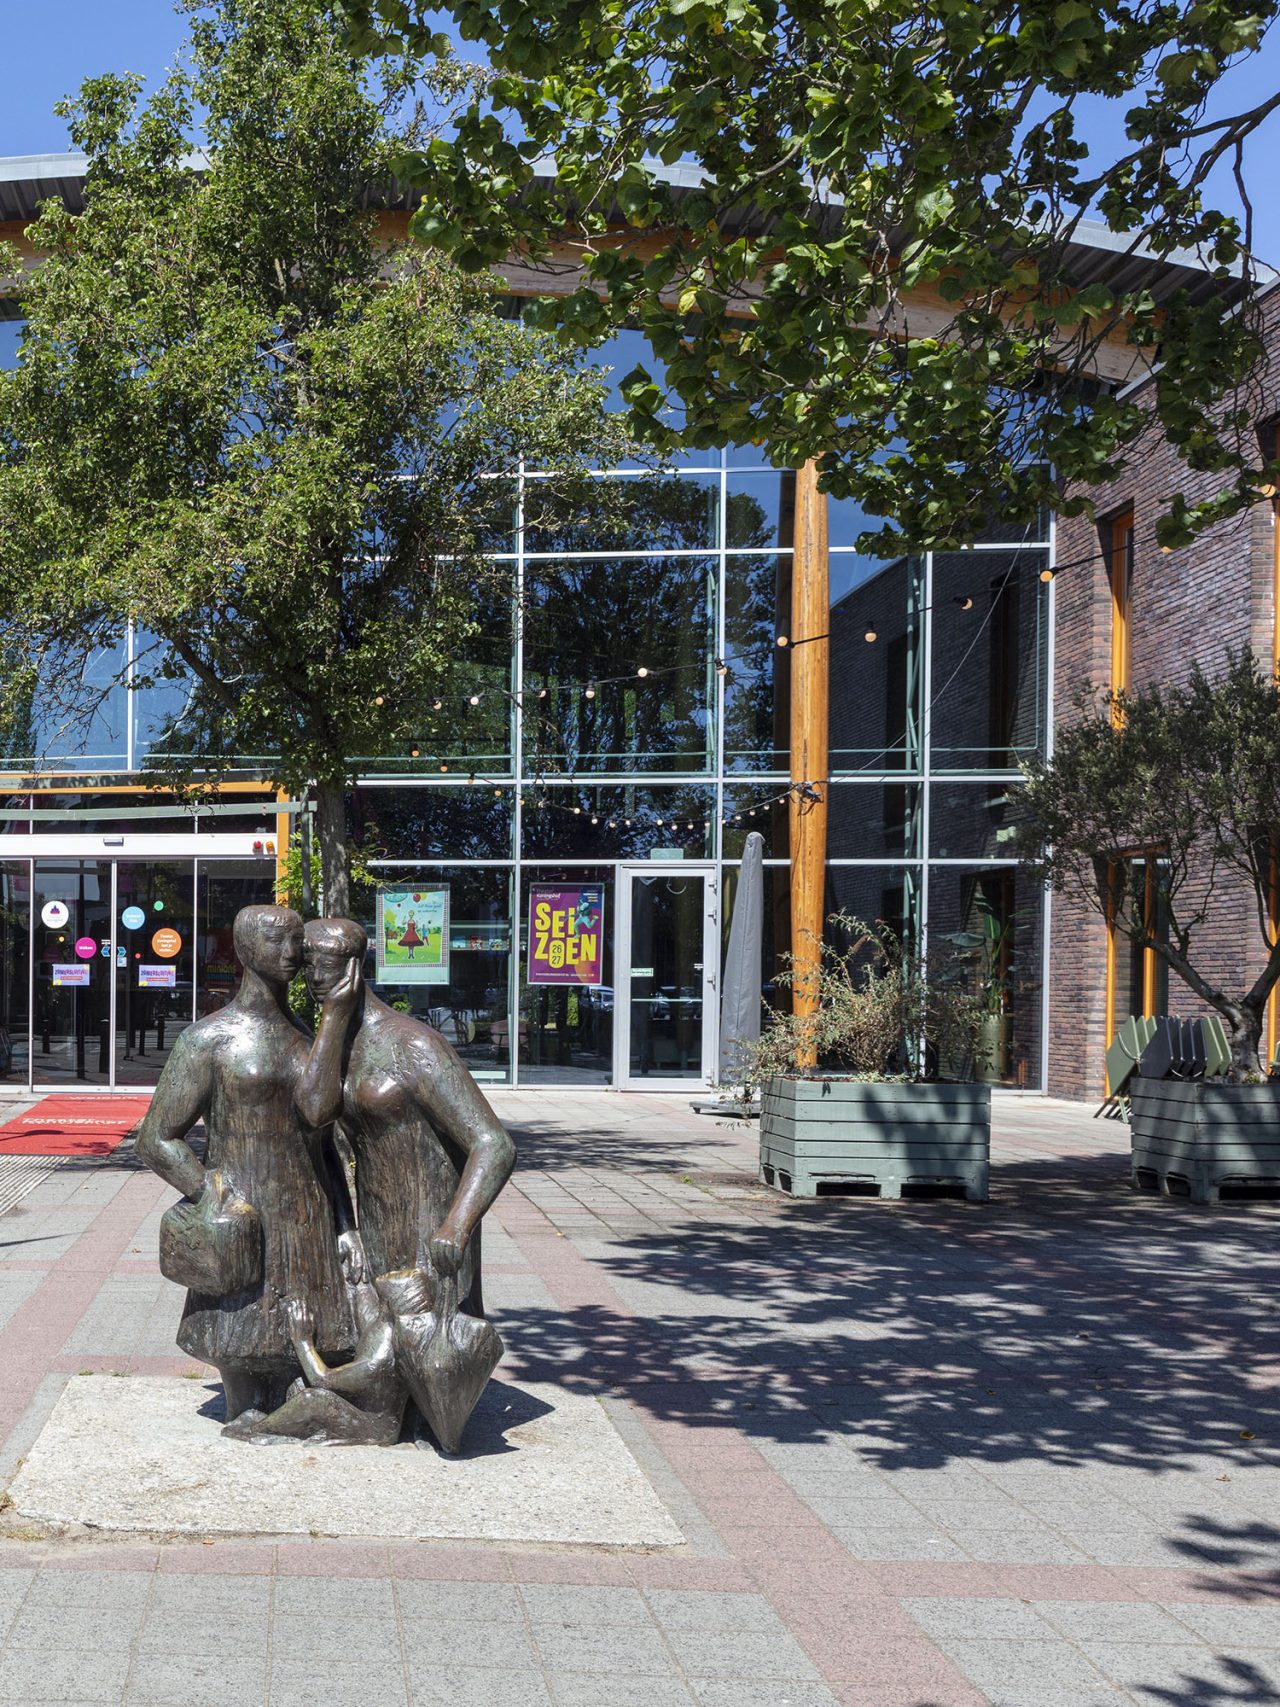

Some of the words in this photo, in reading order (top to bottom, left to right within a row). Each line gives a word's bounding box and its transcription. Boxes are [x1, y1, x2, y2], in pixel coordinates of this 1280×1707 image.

[535, 903, 576, 938] SEI
[552, 944, 562, 954] 26
[551, 955, 561, 965] 27
